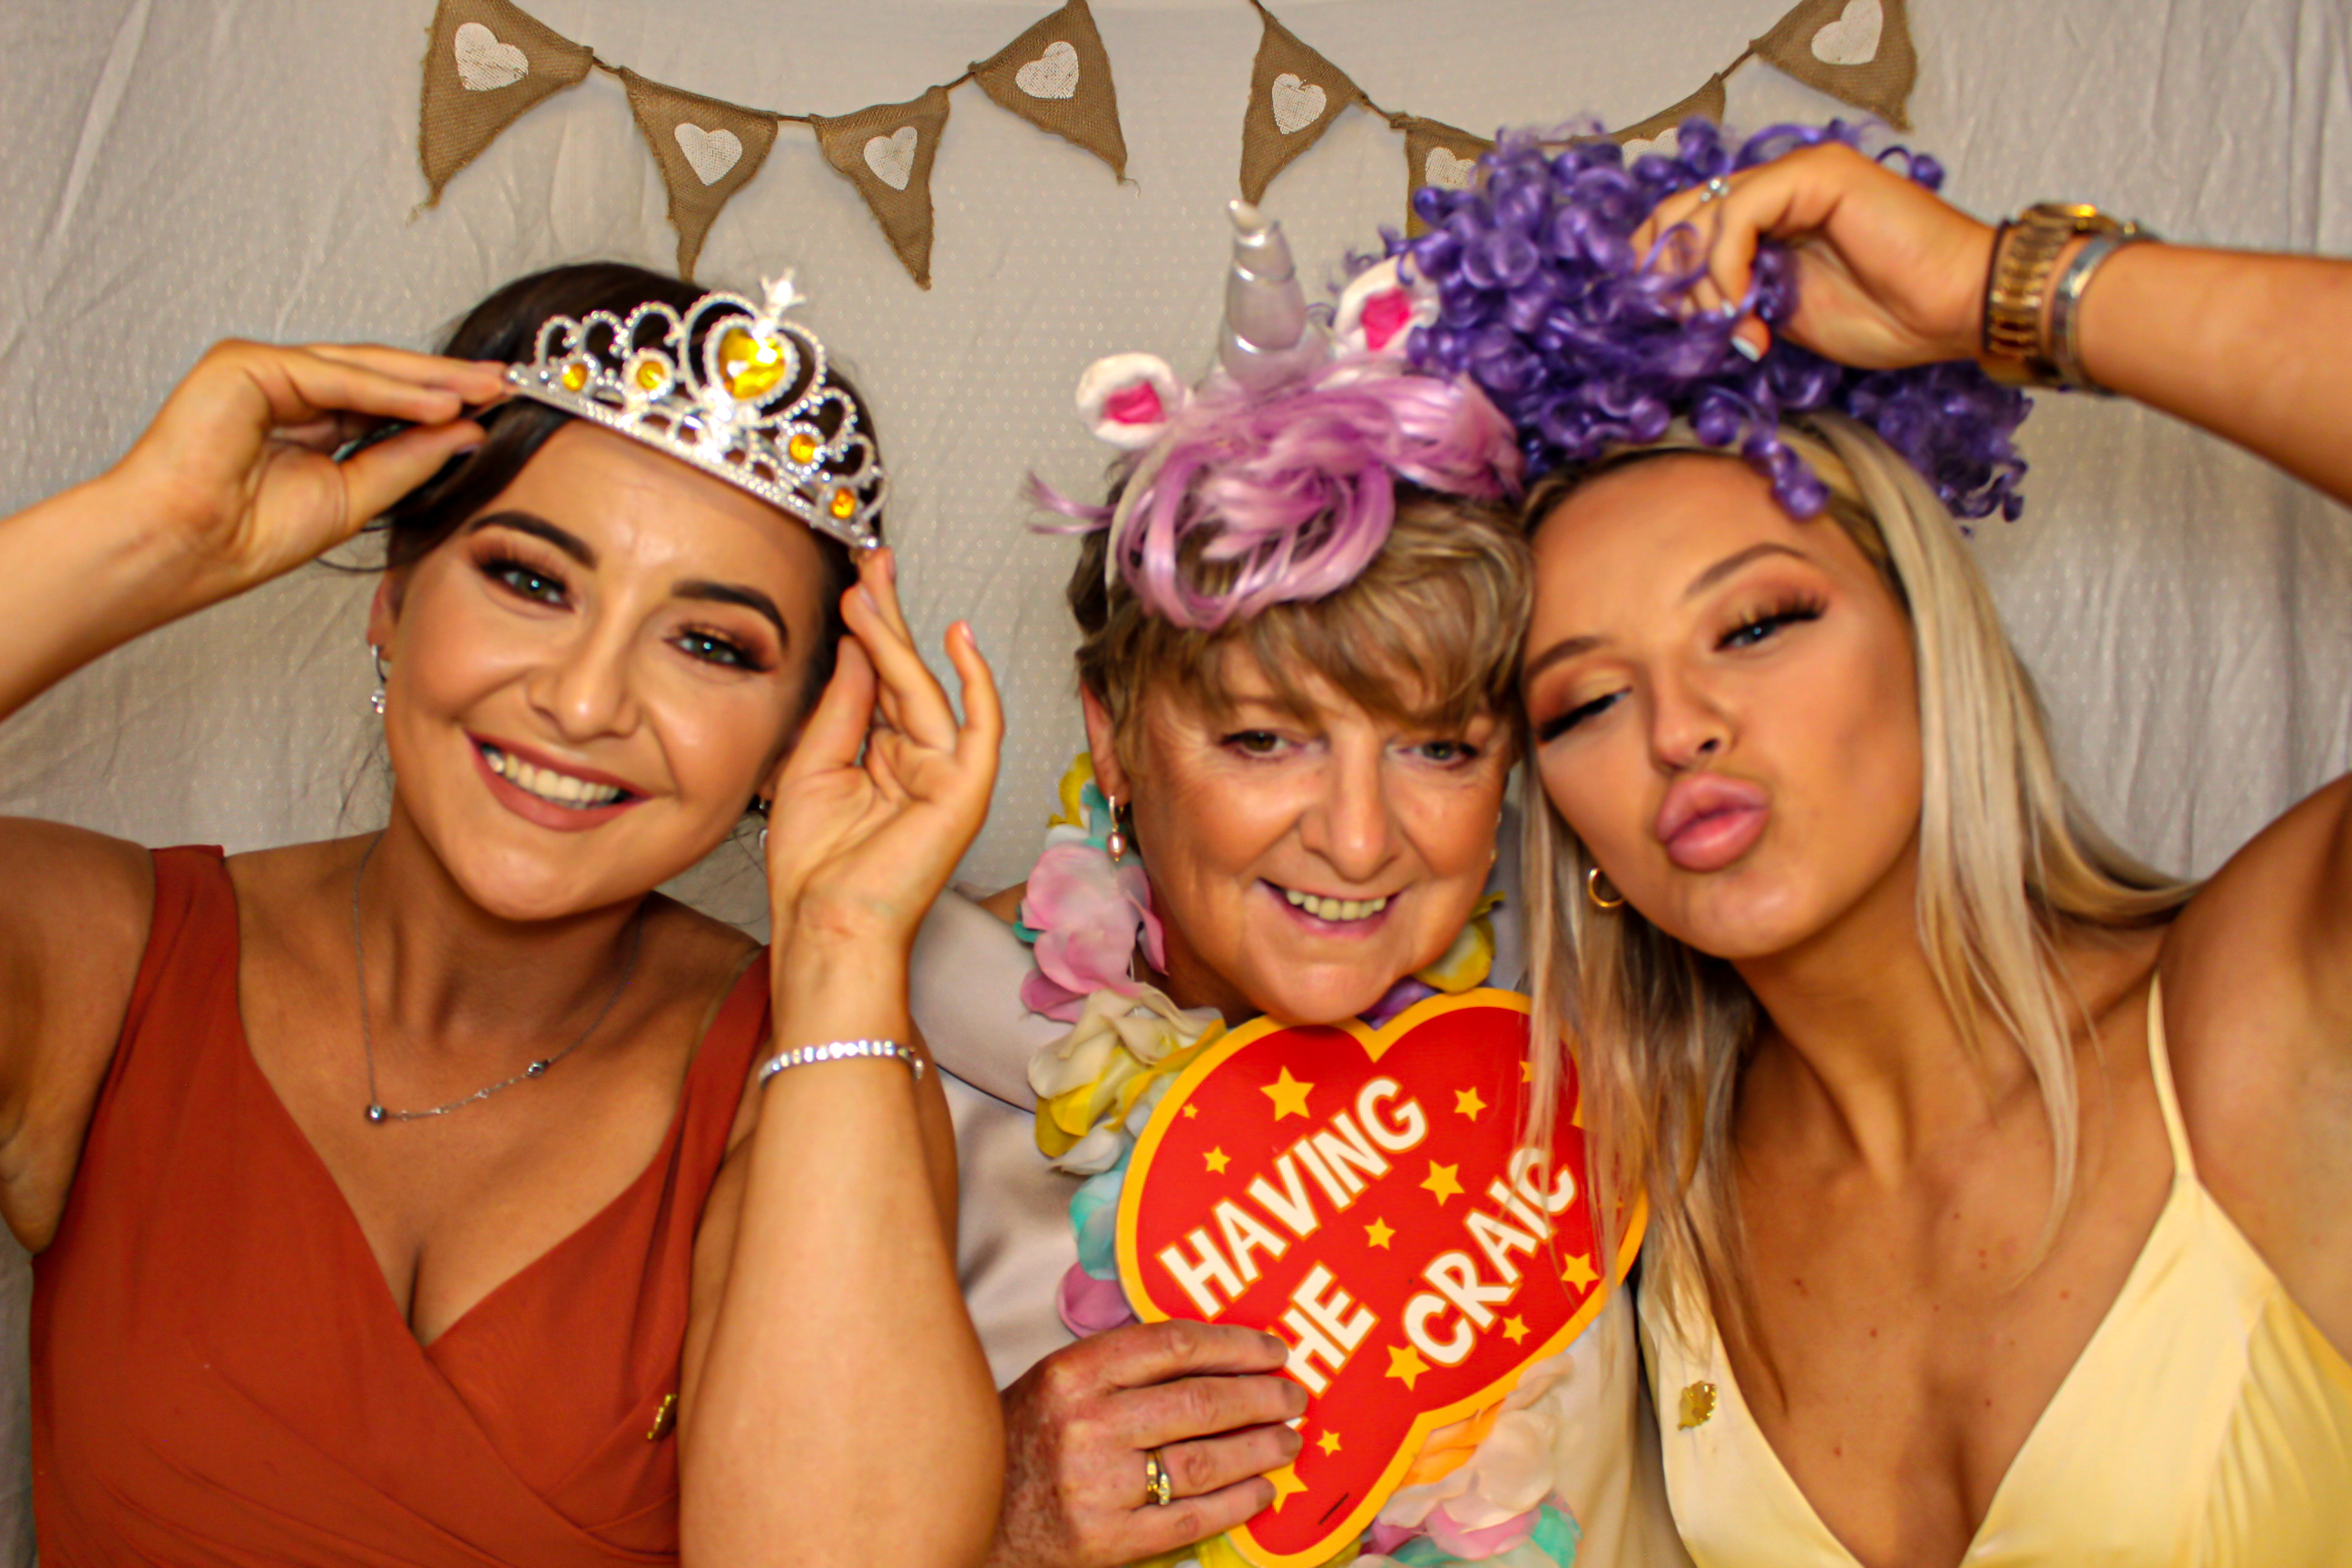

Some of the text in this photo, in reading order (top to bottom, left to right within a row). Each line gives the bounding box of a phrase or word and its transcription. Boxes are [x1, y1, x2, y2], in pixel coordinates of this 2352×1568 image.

[1161, 1078, 1427, 1319] HAVING
[1403, 1147, 1576, 1364] CRAIC
[1268, 1267, 1377, 1429] HE
